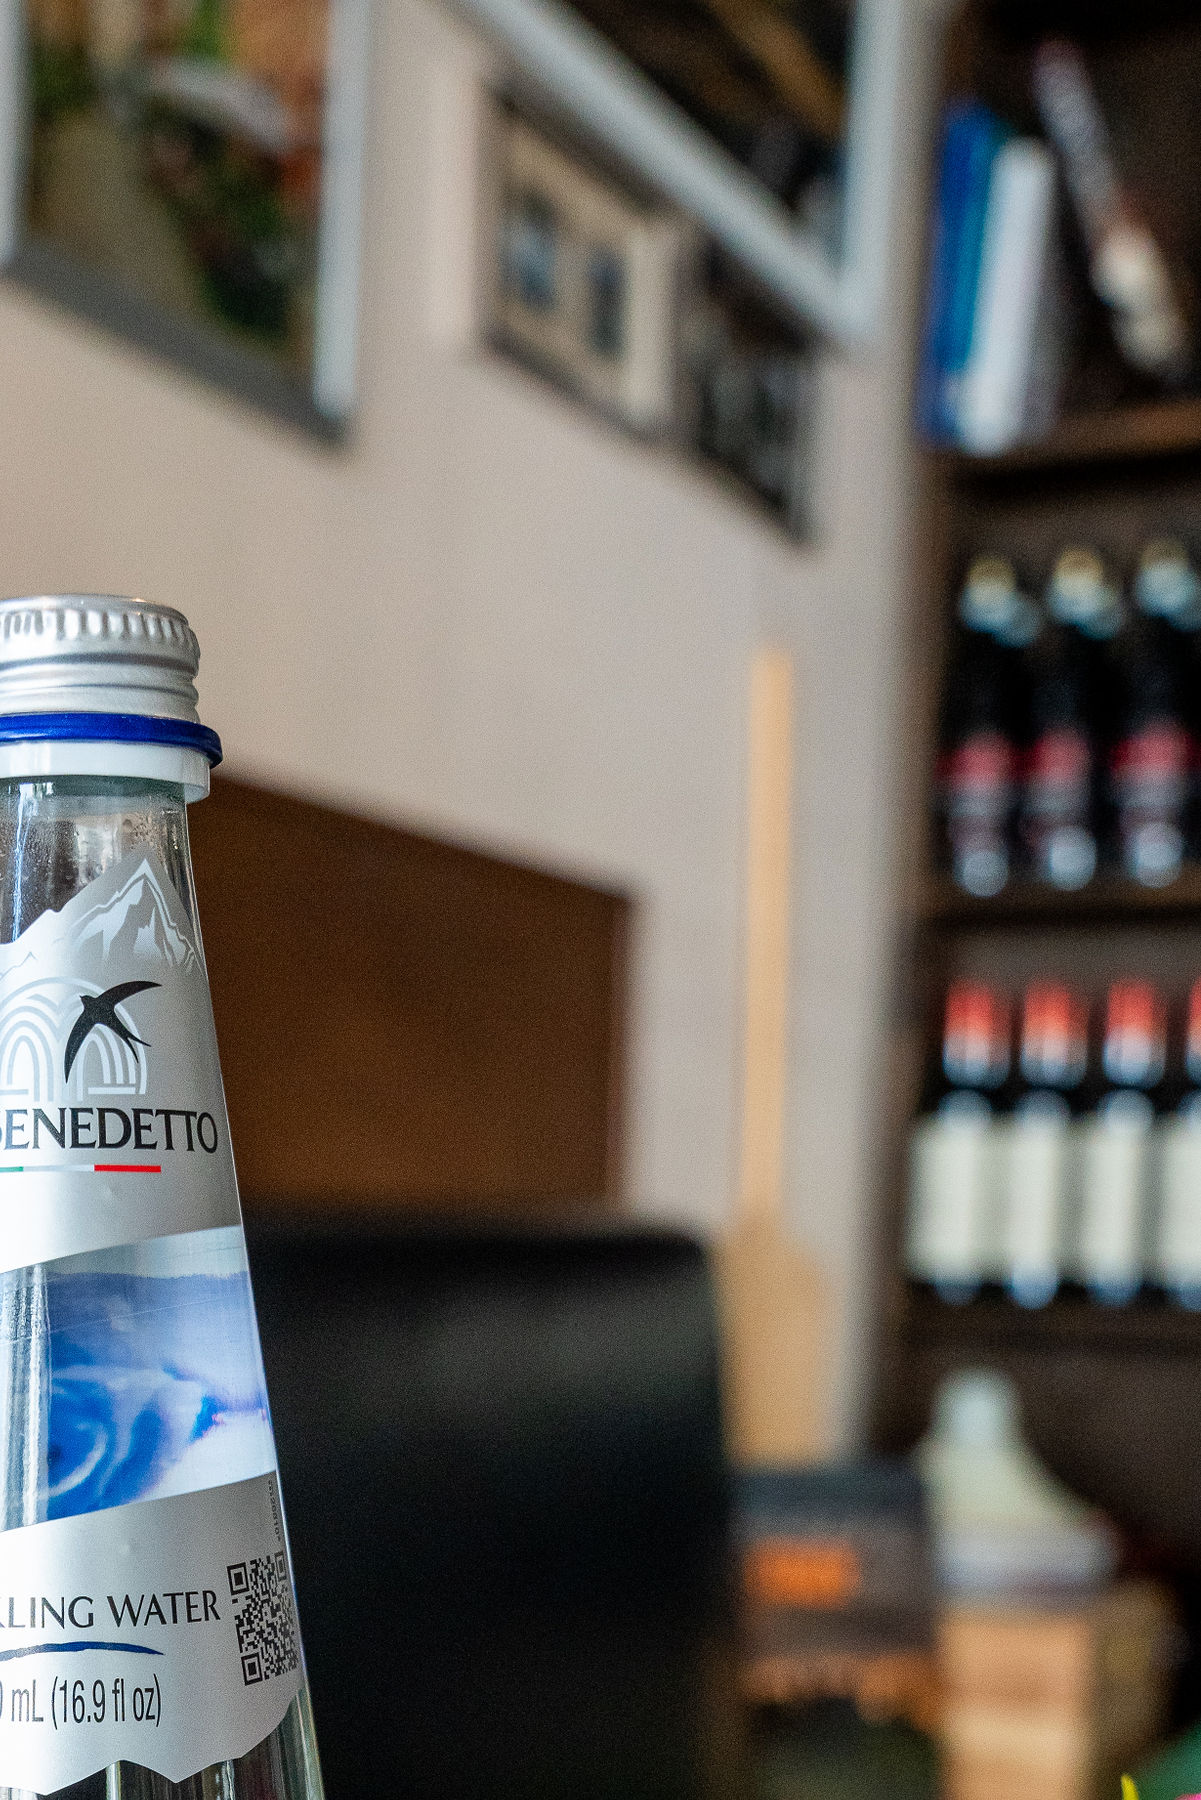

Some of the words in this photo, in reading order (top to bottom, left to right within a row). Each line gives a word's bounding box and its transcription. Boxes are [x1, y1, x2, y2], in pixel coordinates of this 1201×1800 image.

[107, 1589, 222, 1627] WATER
[11, 1678, 44, 1723] mL
[51, 1675, 106, 1730] (16.9
[112, 1677, 126, 1722] fl
[132, 1673, 162, 1728] oz)
